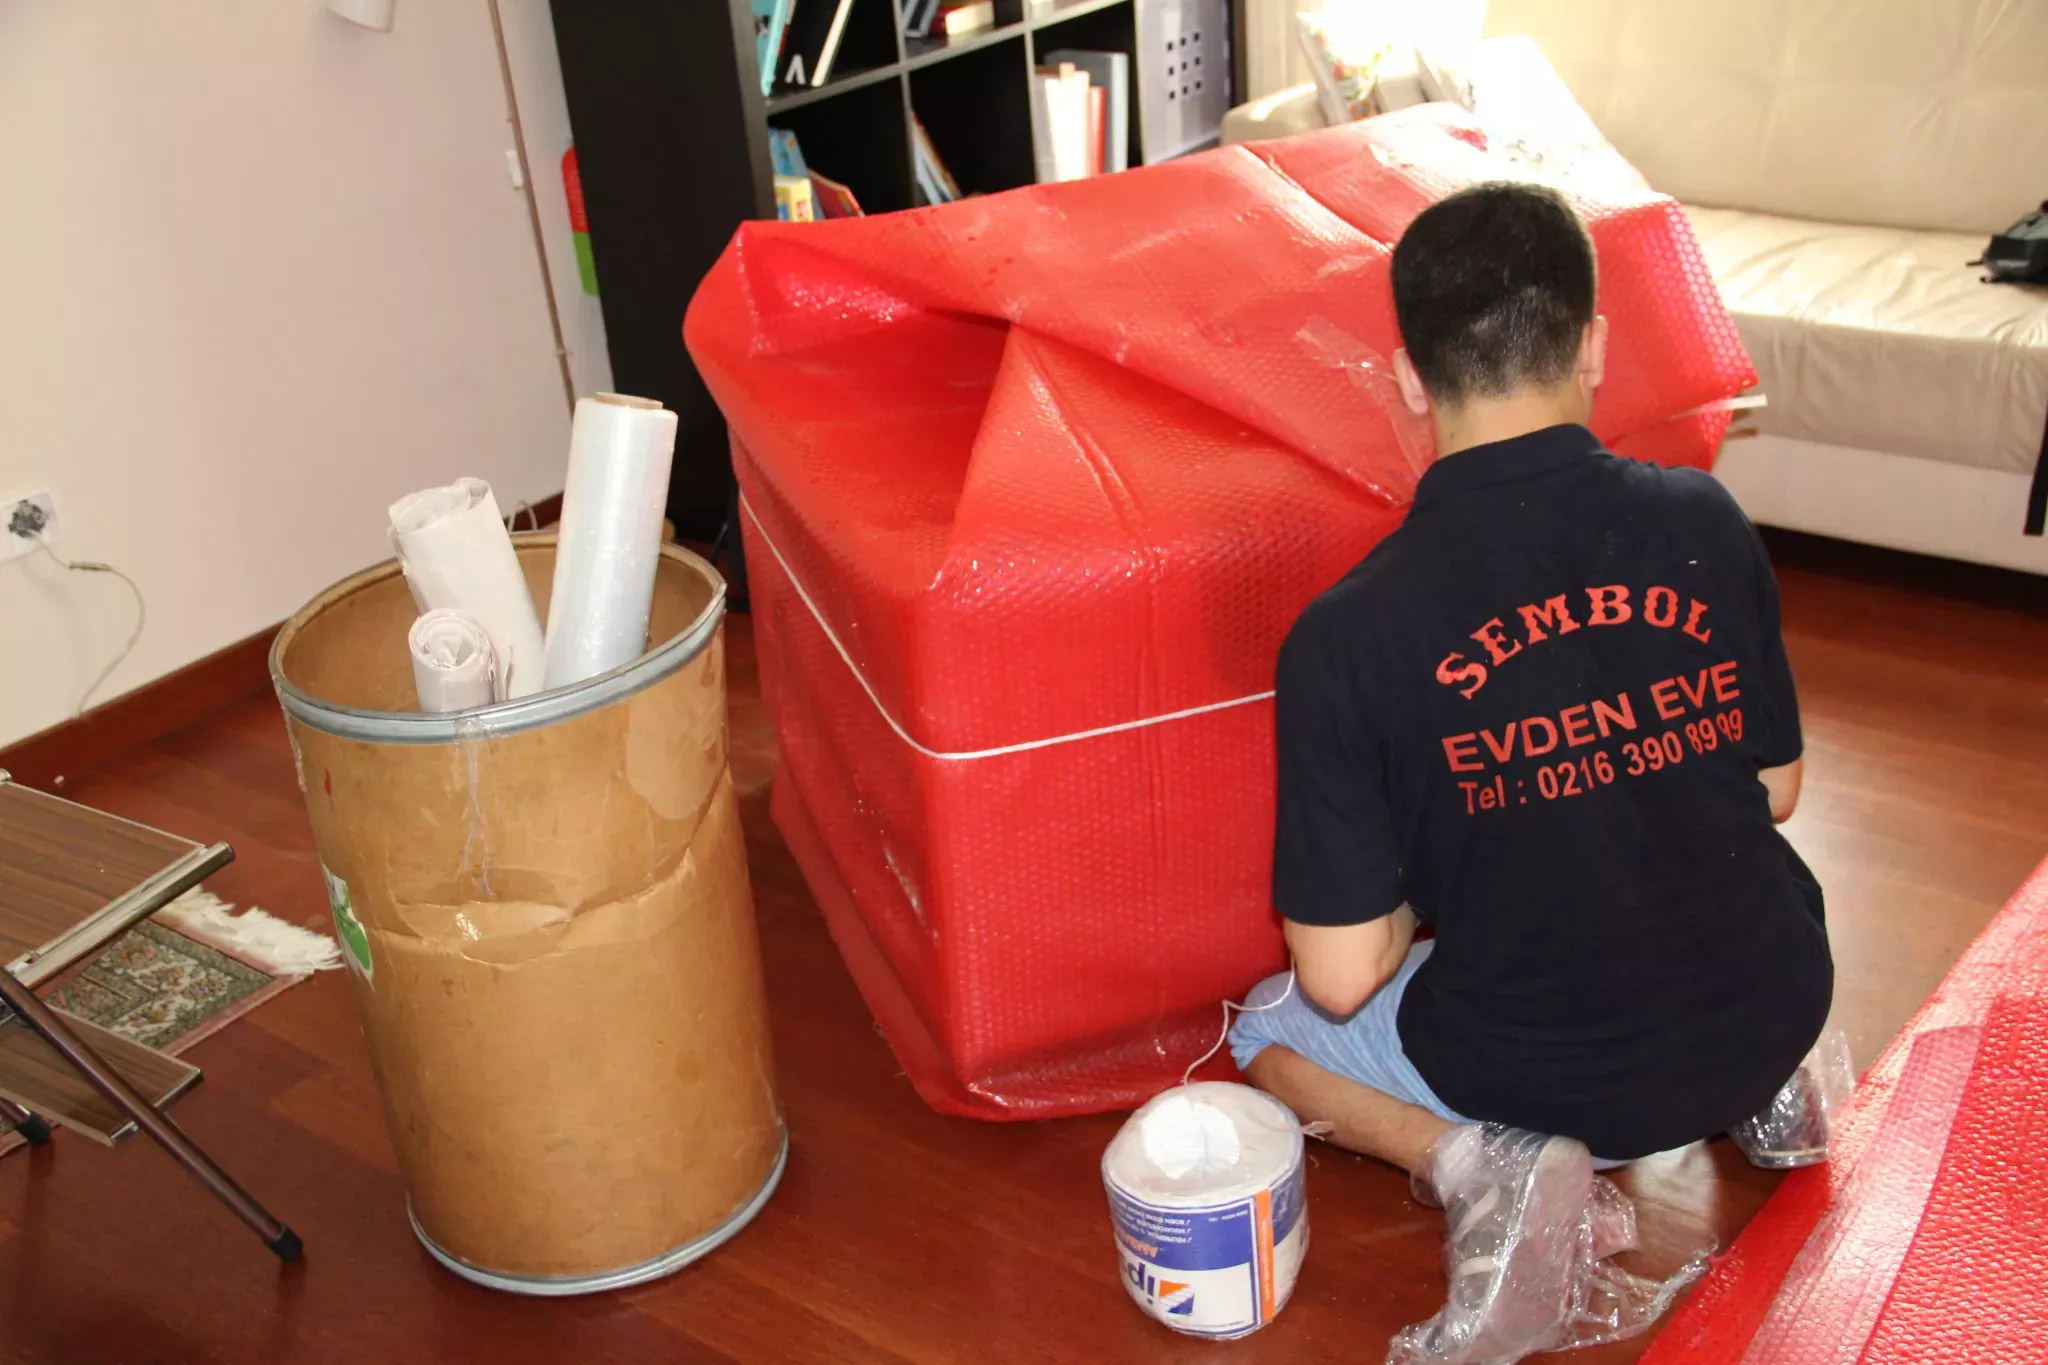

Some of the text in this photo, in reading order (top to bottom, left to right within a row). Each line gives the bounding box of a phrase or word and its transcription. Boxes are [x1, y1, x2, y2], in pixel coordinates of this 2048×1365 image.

[1436, 583, 1713, 700] SEMBOL
[1441, 660, 1741, 773] EVDEN EVE
[1536, 750, 1616, 801] 0216
[1622, 729, 1684, 776] 390
